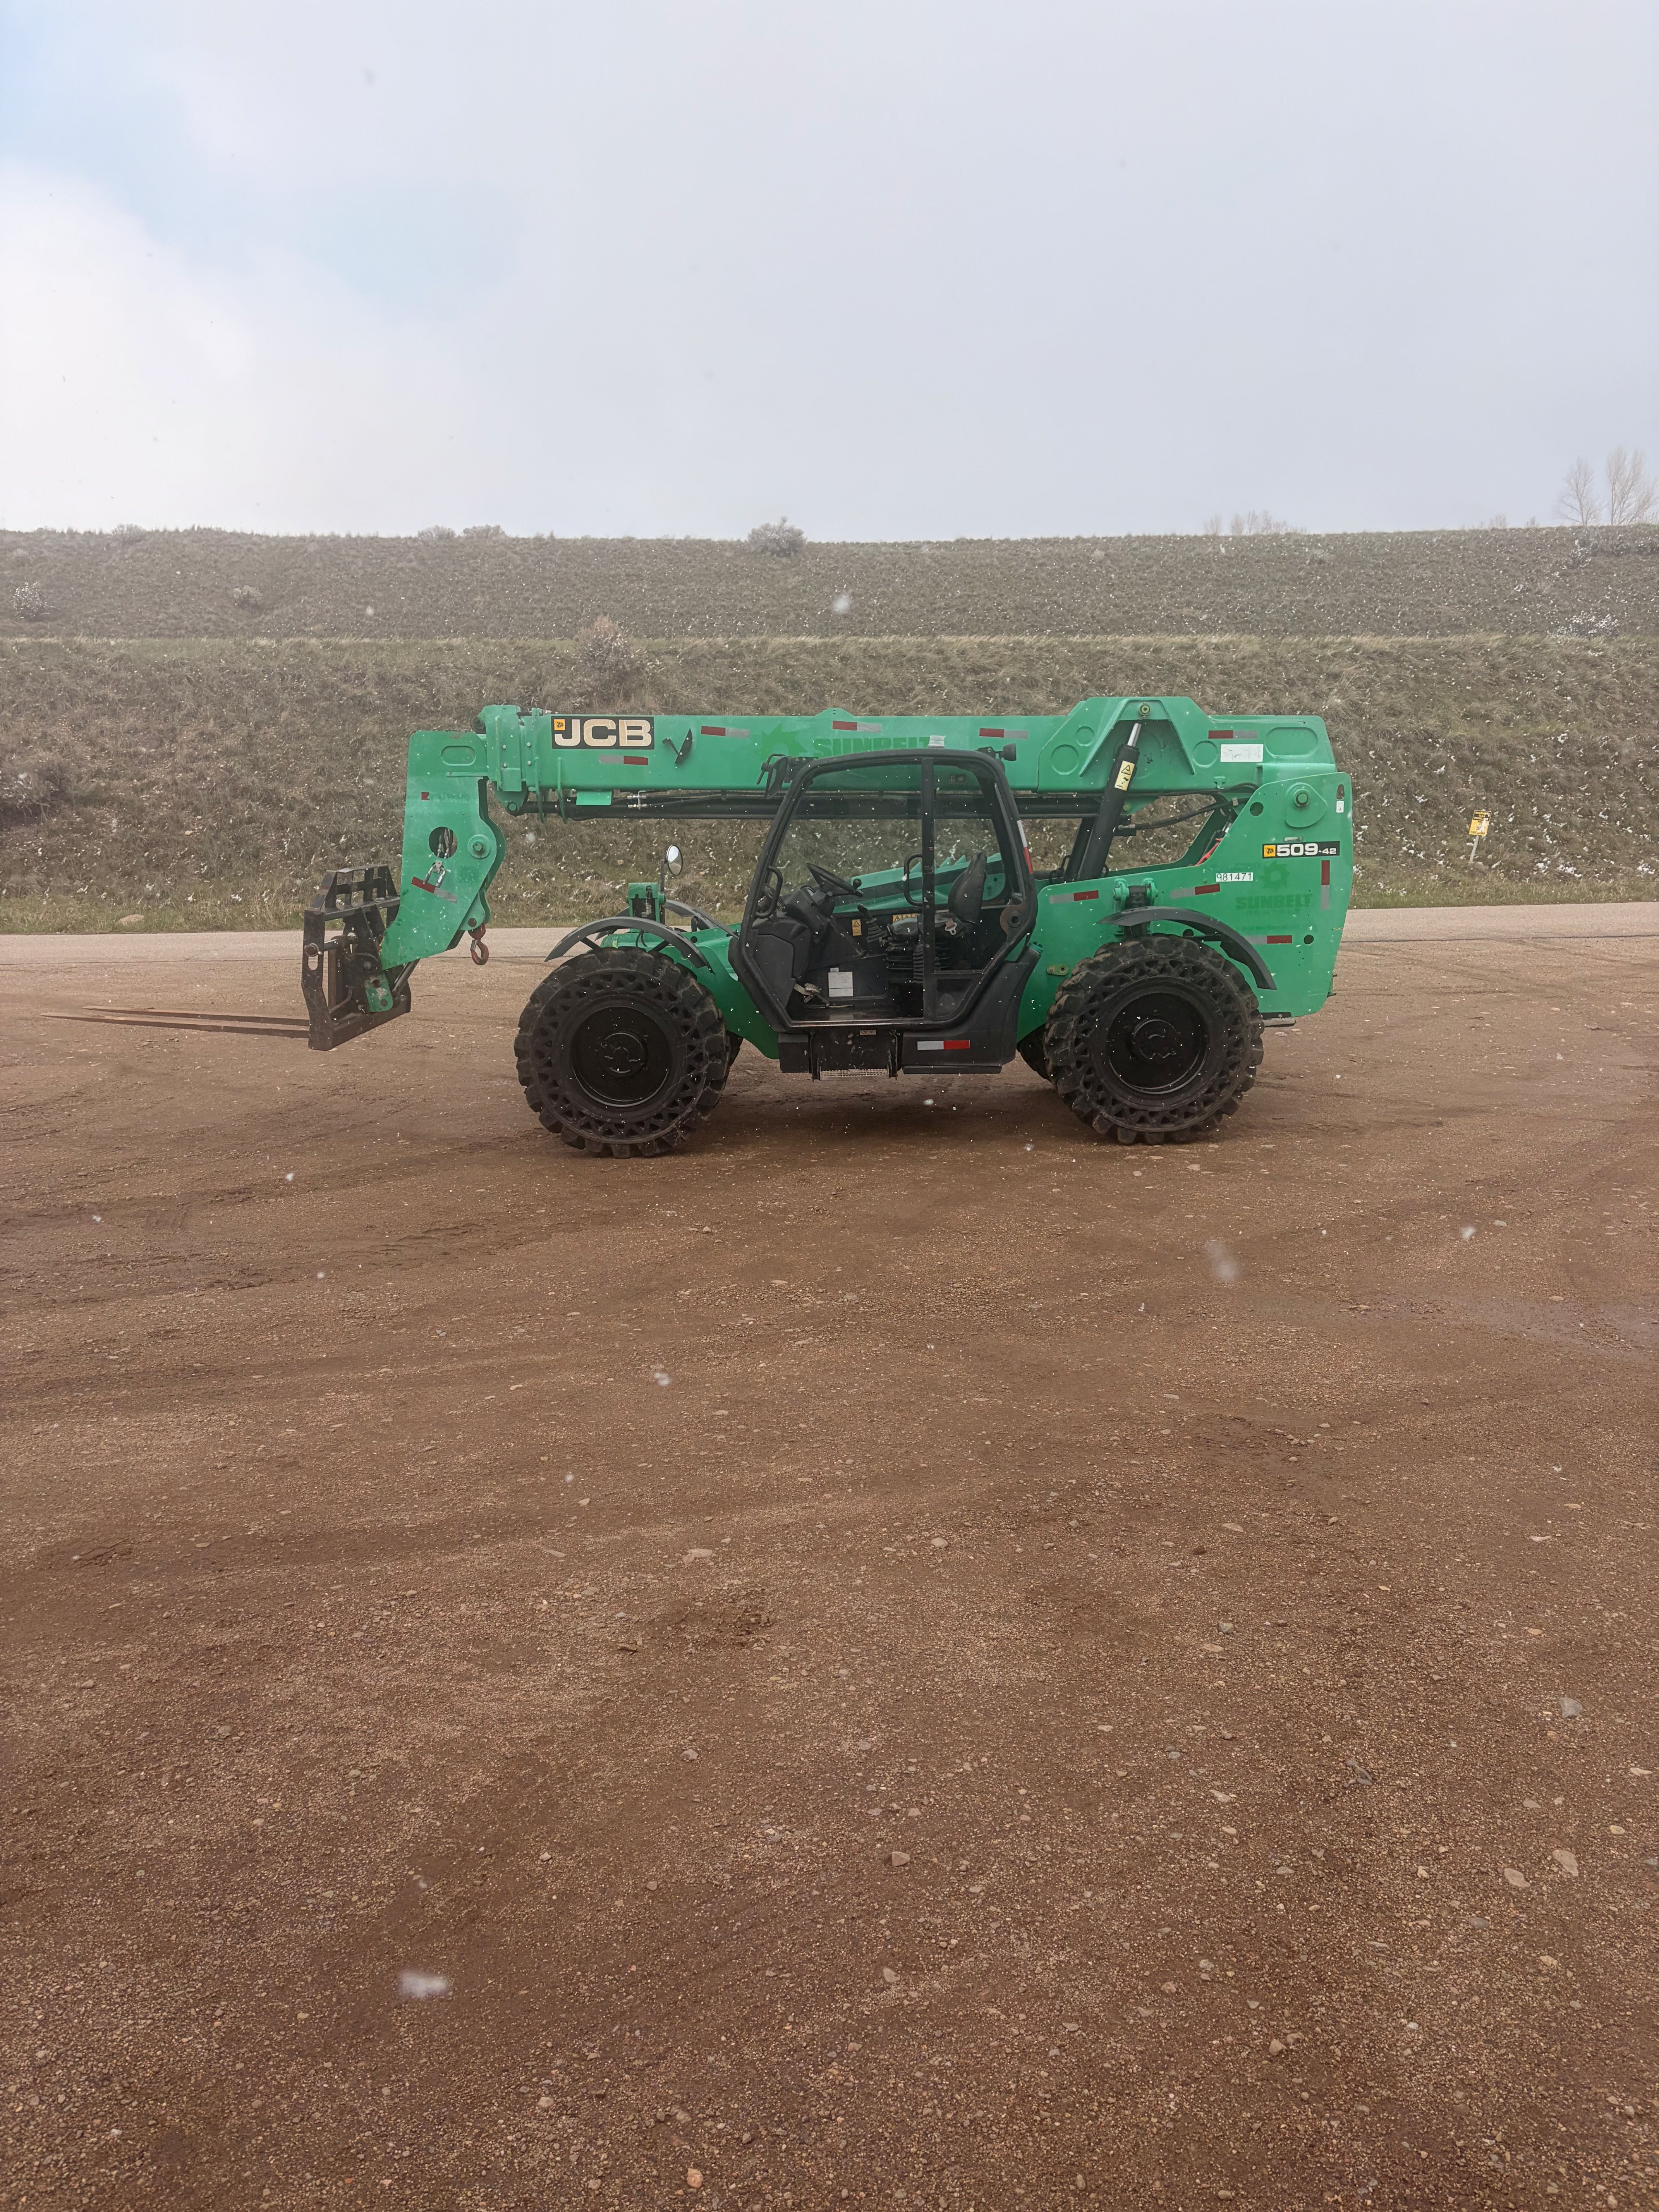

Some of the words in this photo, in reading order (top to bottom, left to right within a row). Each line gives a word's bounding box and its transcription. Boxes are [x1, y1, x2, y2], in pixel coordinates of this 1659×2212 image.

[555, 719, 652, 747] JCB
[1277, 843, 1337, 857] 509-42
[1217, 873, 1251, 881] 981471
[1235, 893, 1313, 910] SUNBELT
